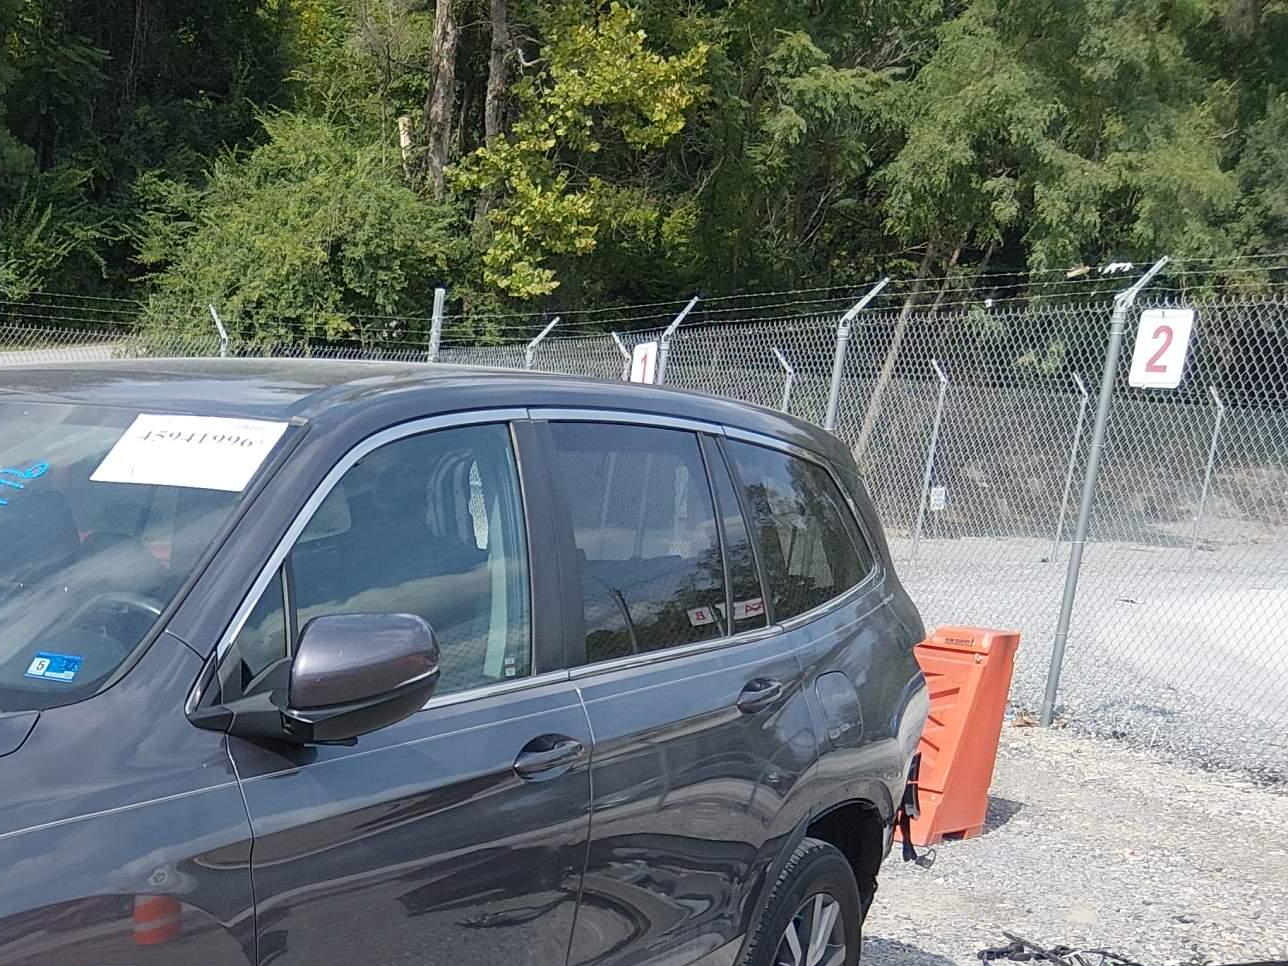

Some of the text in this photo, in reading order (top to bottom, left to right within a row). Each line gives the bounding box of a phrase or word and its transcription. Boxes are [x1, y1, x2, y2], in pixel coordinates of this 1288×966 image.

[1145, 325, 1174, 373] 2
[640, 353, 648, 384] 1
[36, 660, 47, 671] 5
